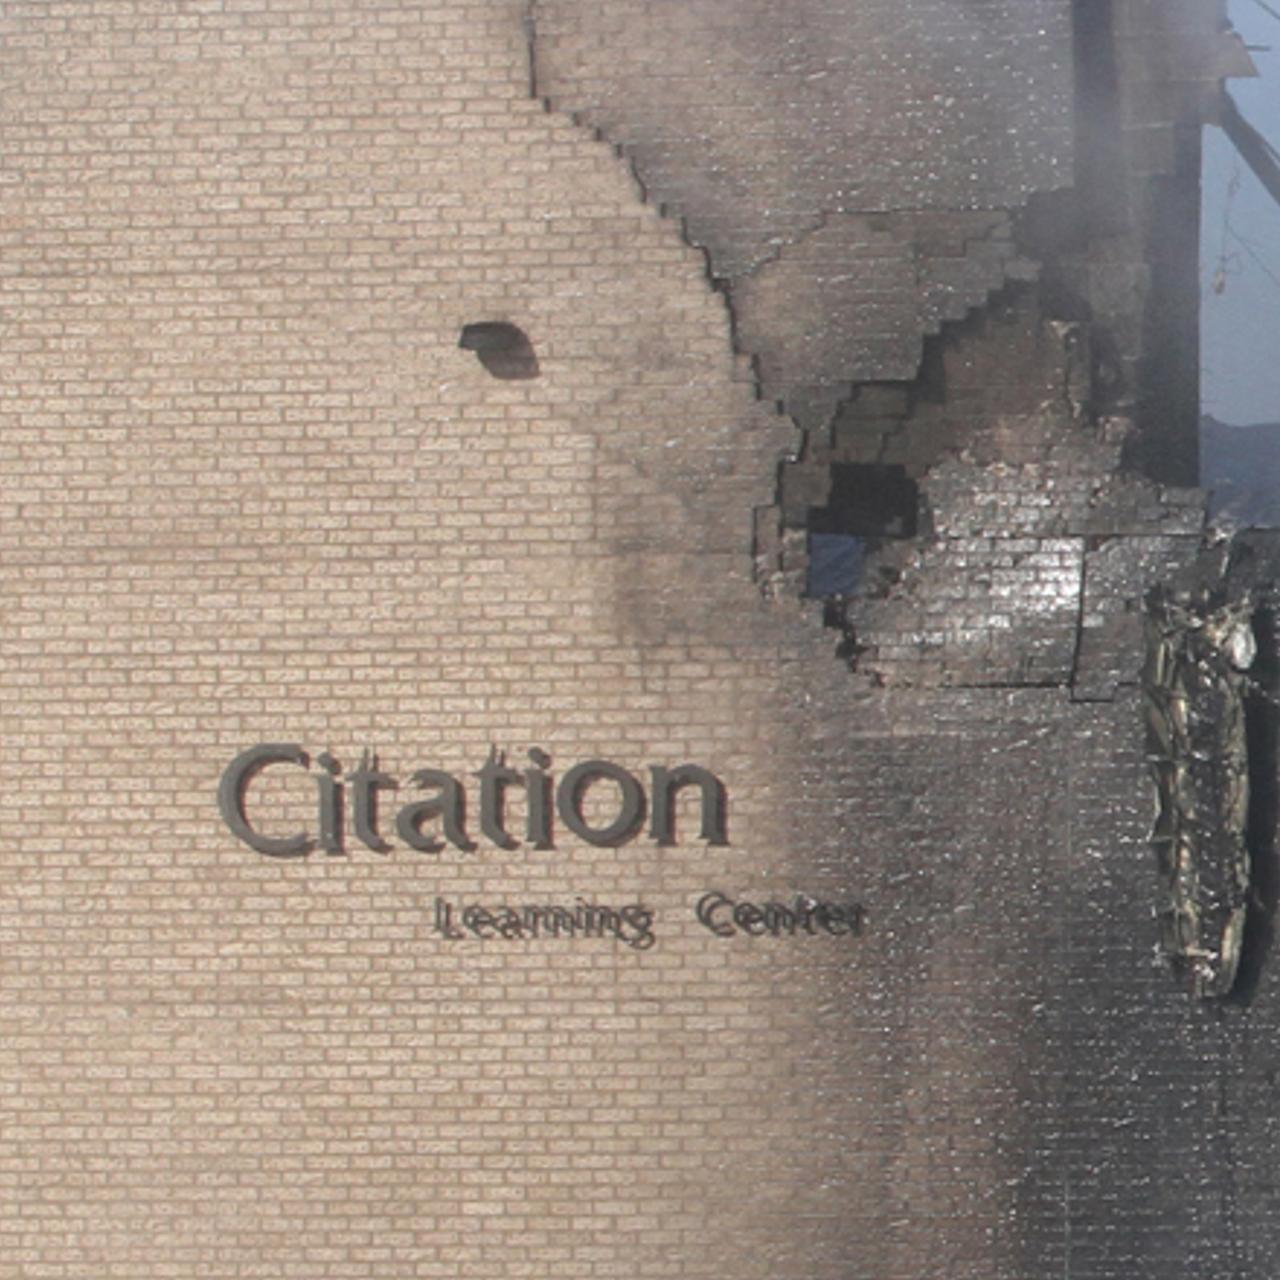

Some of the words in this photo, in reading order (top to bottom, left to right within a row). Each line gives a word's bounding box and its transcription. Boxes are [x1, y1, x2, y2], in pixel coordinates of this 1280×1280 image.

[217, 742, 731, 858] Citation
[434, 896, 656, 950] Learning
[696, 891, 866, 937] Center
